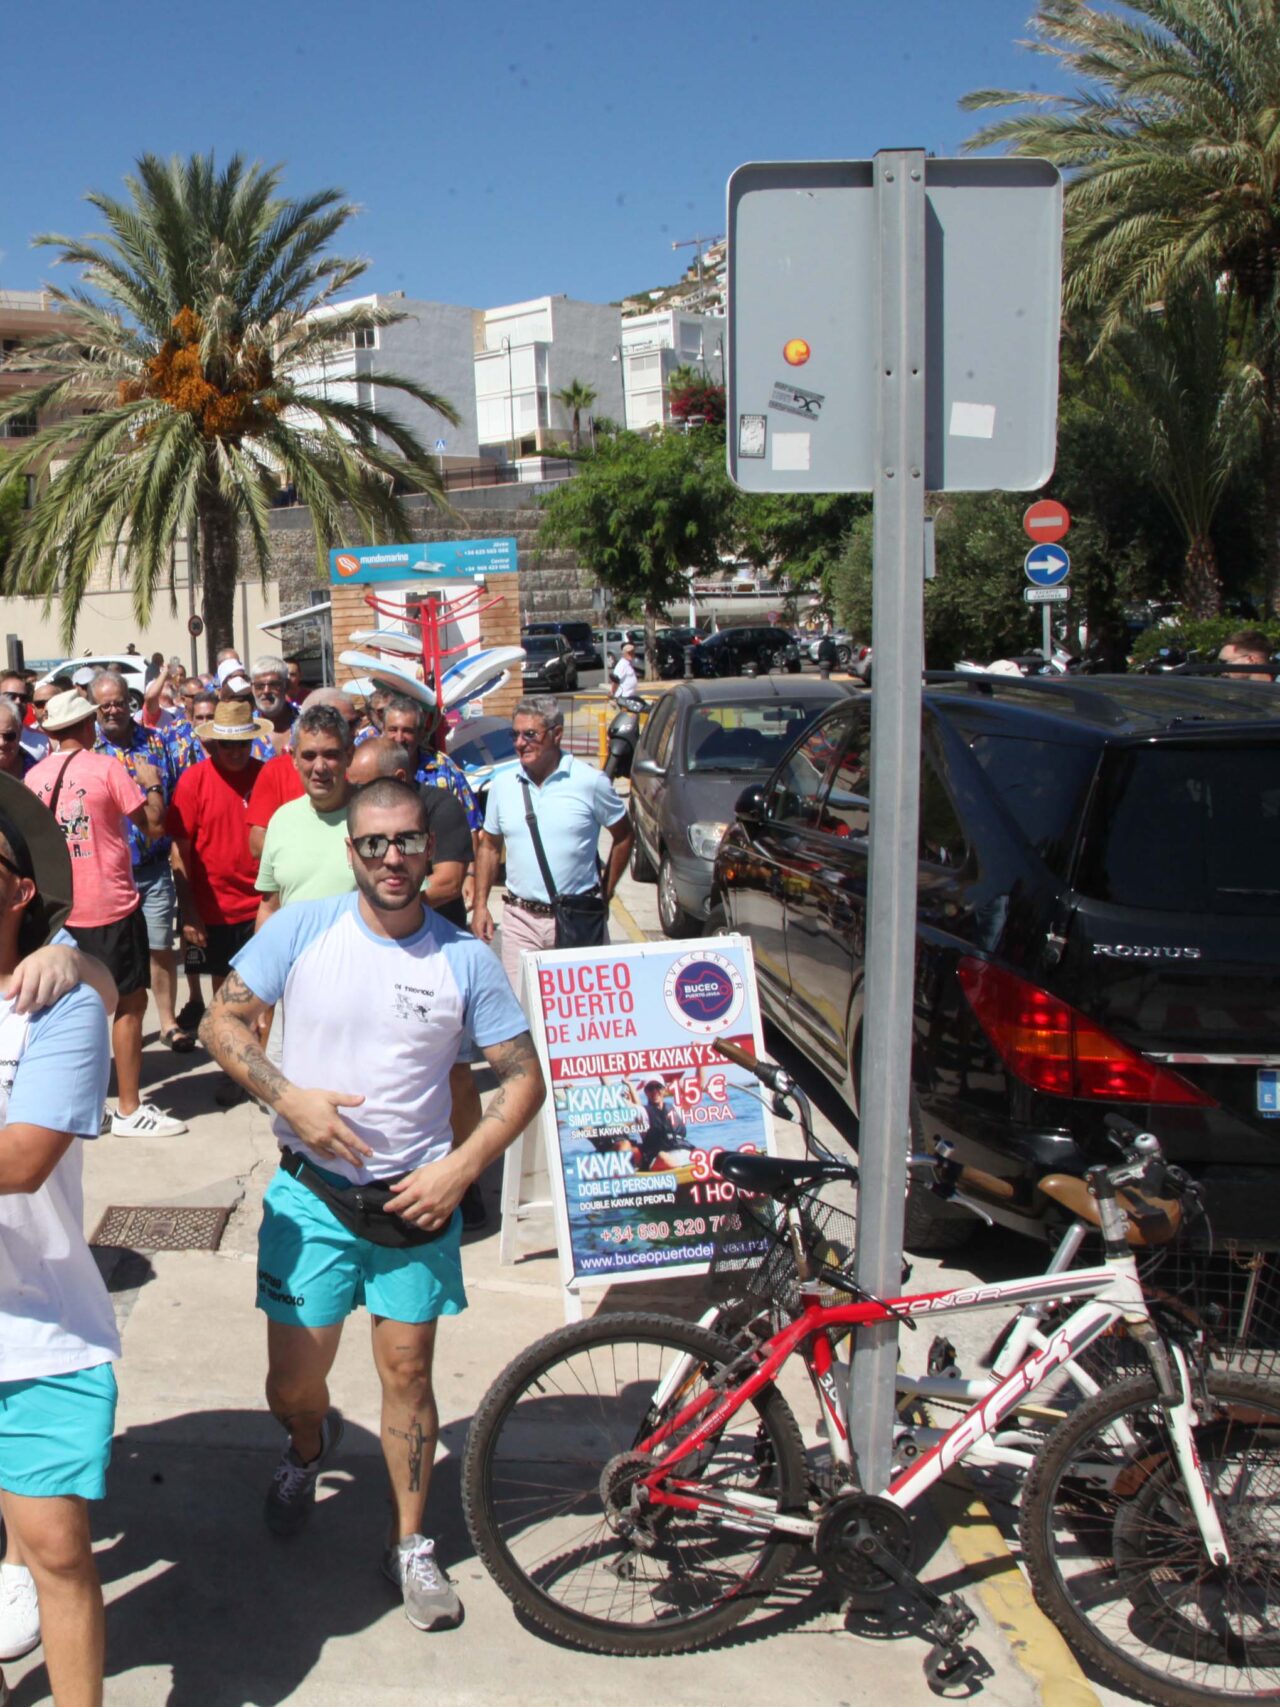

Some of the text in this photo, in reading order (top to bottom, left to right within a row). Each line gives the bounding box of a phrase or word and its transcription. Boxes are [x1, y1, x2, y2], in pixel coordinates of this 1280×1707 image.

[1093, 943, 1202, 958] RODIUS
[539, 961, 631, 996] BUCEO
[665, 952, 744, 997] DIVE CENTER
[684, 982, 719, 994] BUCEO
[542, 990, 634, 1020] PUERTO
[546, 1016, 638, 1045] DE JÁVEA
[560, 1051, 627, 1078] ALQUILER
[628, 1051, 647, 1074] DE
[649, 1045, 694, 1070] KAYAK
[694, 1045, 704, 1064] Y
[566, 1084, 626, 1113] KAYAK
[668, 1074, 727, 1105] 15 €
[1263, 1094, 1273, 1104] E
[568, 1110, 603, 1127] SIMPLE
[603, 1110, 612, 1124] O
[668, 1105, 734, 1125] 1 HORA
[571, 1128, 598, 1139] SINGLE
[598, 1126, 623, 1137] KAYAK
[623, 1125, 630, 1134] O
[577, 1151, 635, 1179] KAYAK
[578, 1181, 610, 1197] DOBLE
[622, 1174, 677, 1192] PERSONAS)
[690, 1185, 700, 1204] 1
[579, 1199, 610, 1211] DOUBLE
[611, 1197, 635, 1208] KAYAK
[643, 1193, 675, 1206] PEOPLE)
[601, 1225, 632, 1244] +34
[637, 1220, 670, 1241] 690
[674, 1218, 706, 1236] 320
[886, 1287, 1002, 1316] CONOR
